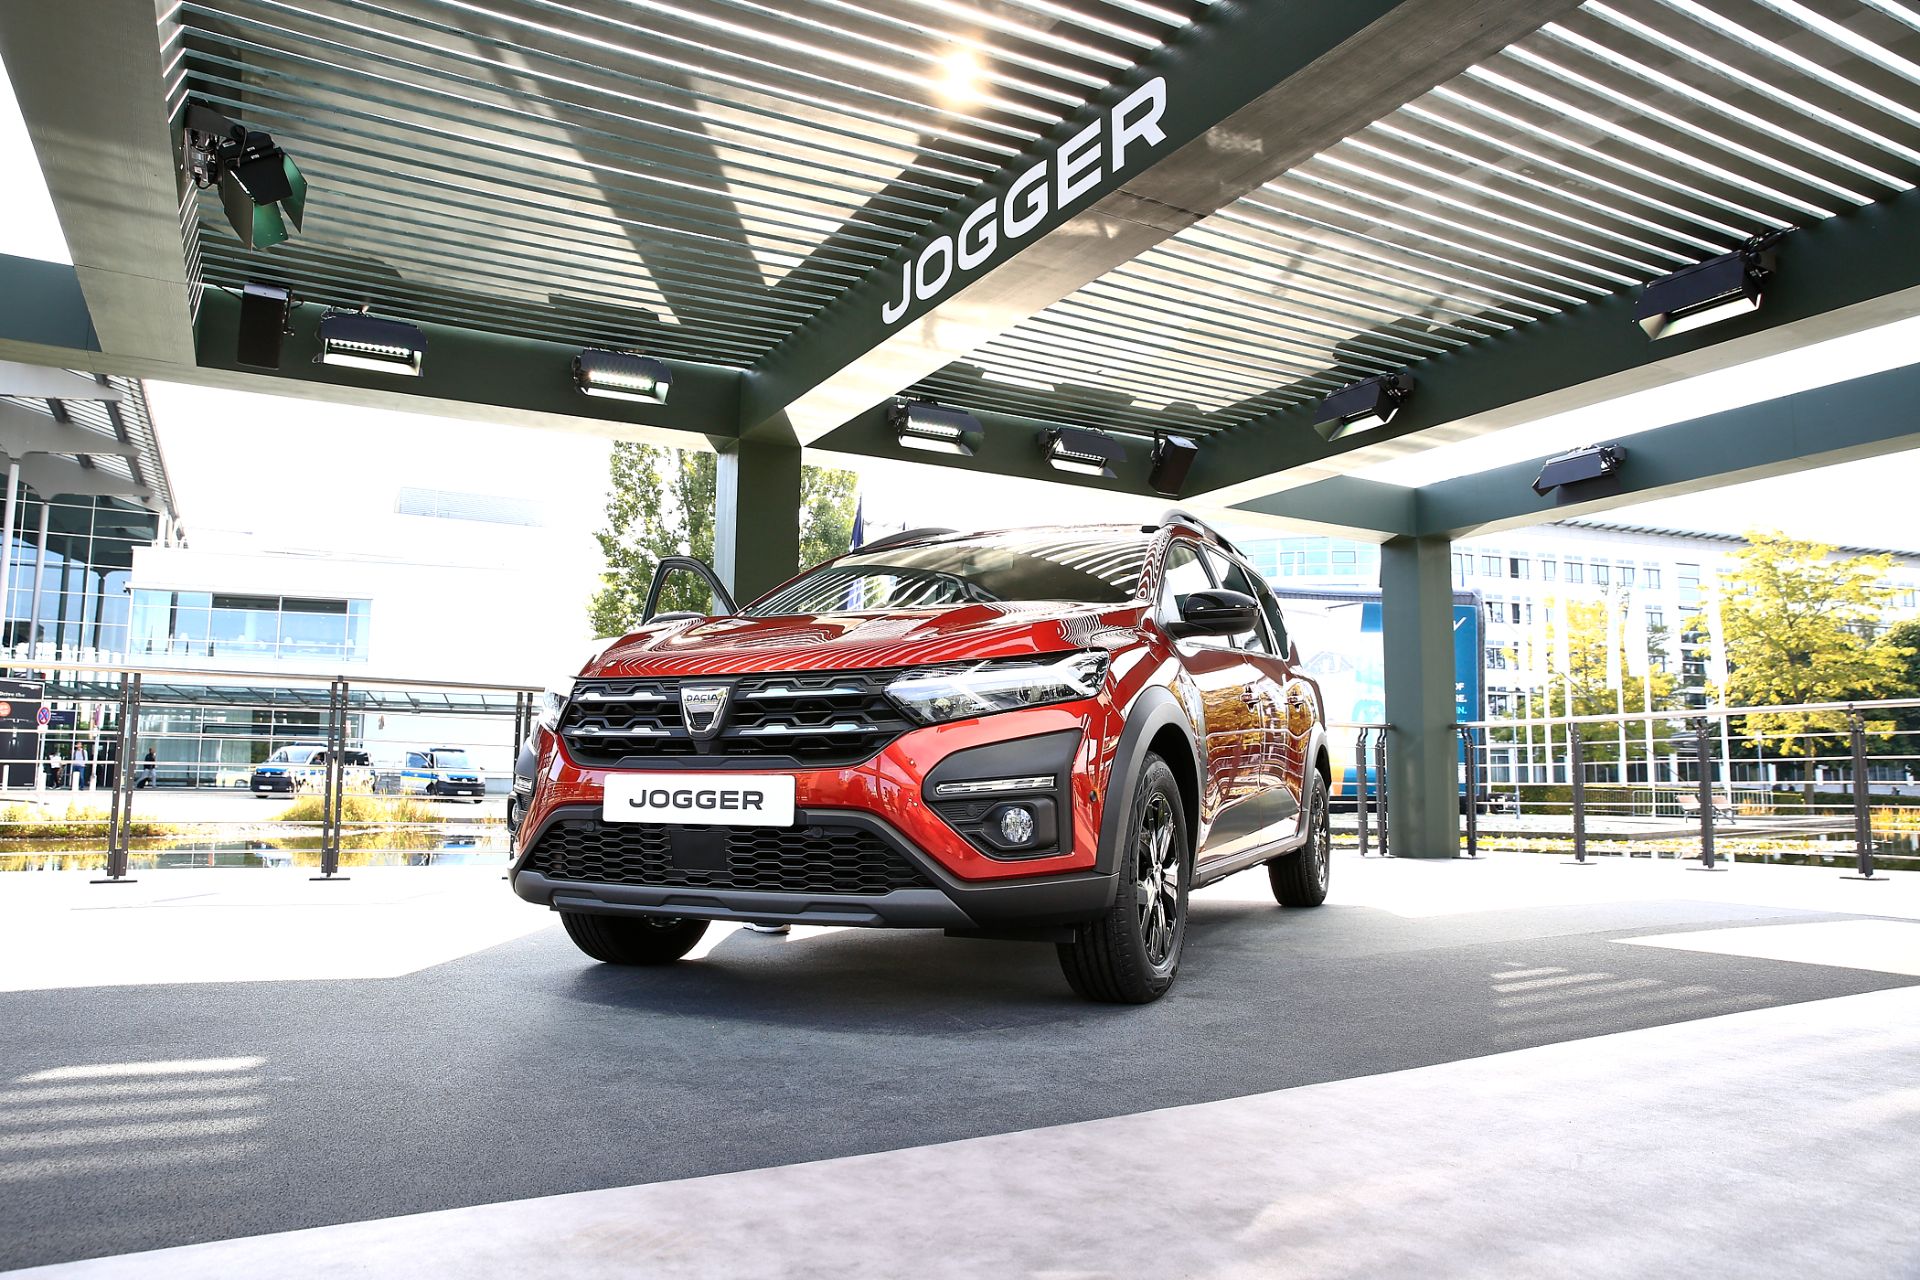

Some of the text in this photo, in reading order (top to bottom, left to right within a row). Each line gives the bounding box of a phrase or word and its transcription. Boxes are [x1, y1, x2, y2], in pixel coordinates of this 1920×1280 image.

[882, 76, 1167, 325] JOGGER
[686, 694, 719, 702] DACIA
[629, 789, 764, 810] JOGGER
